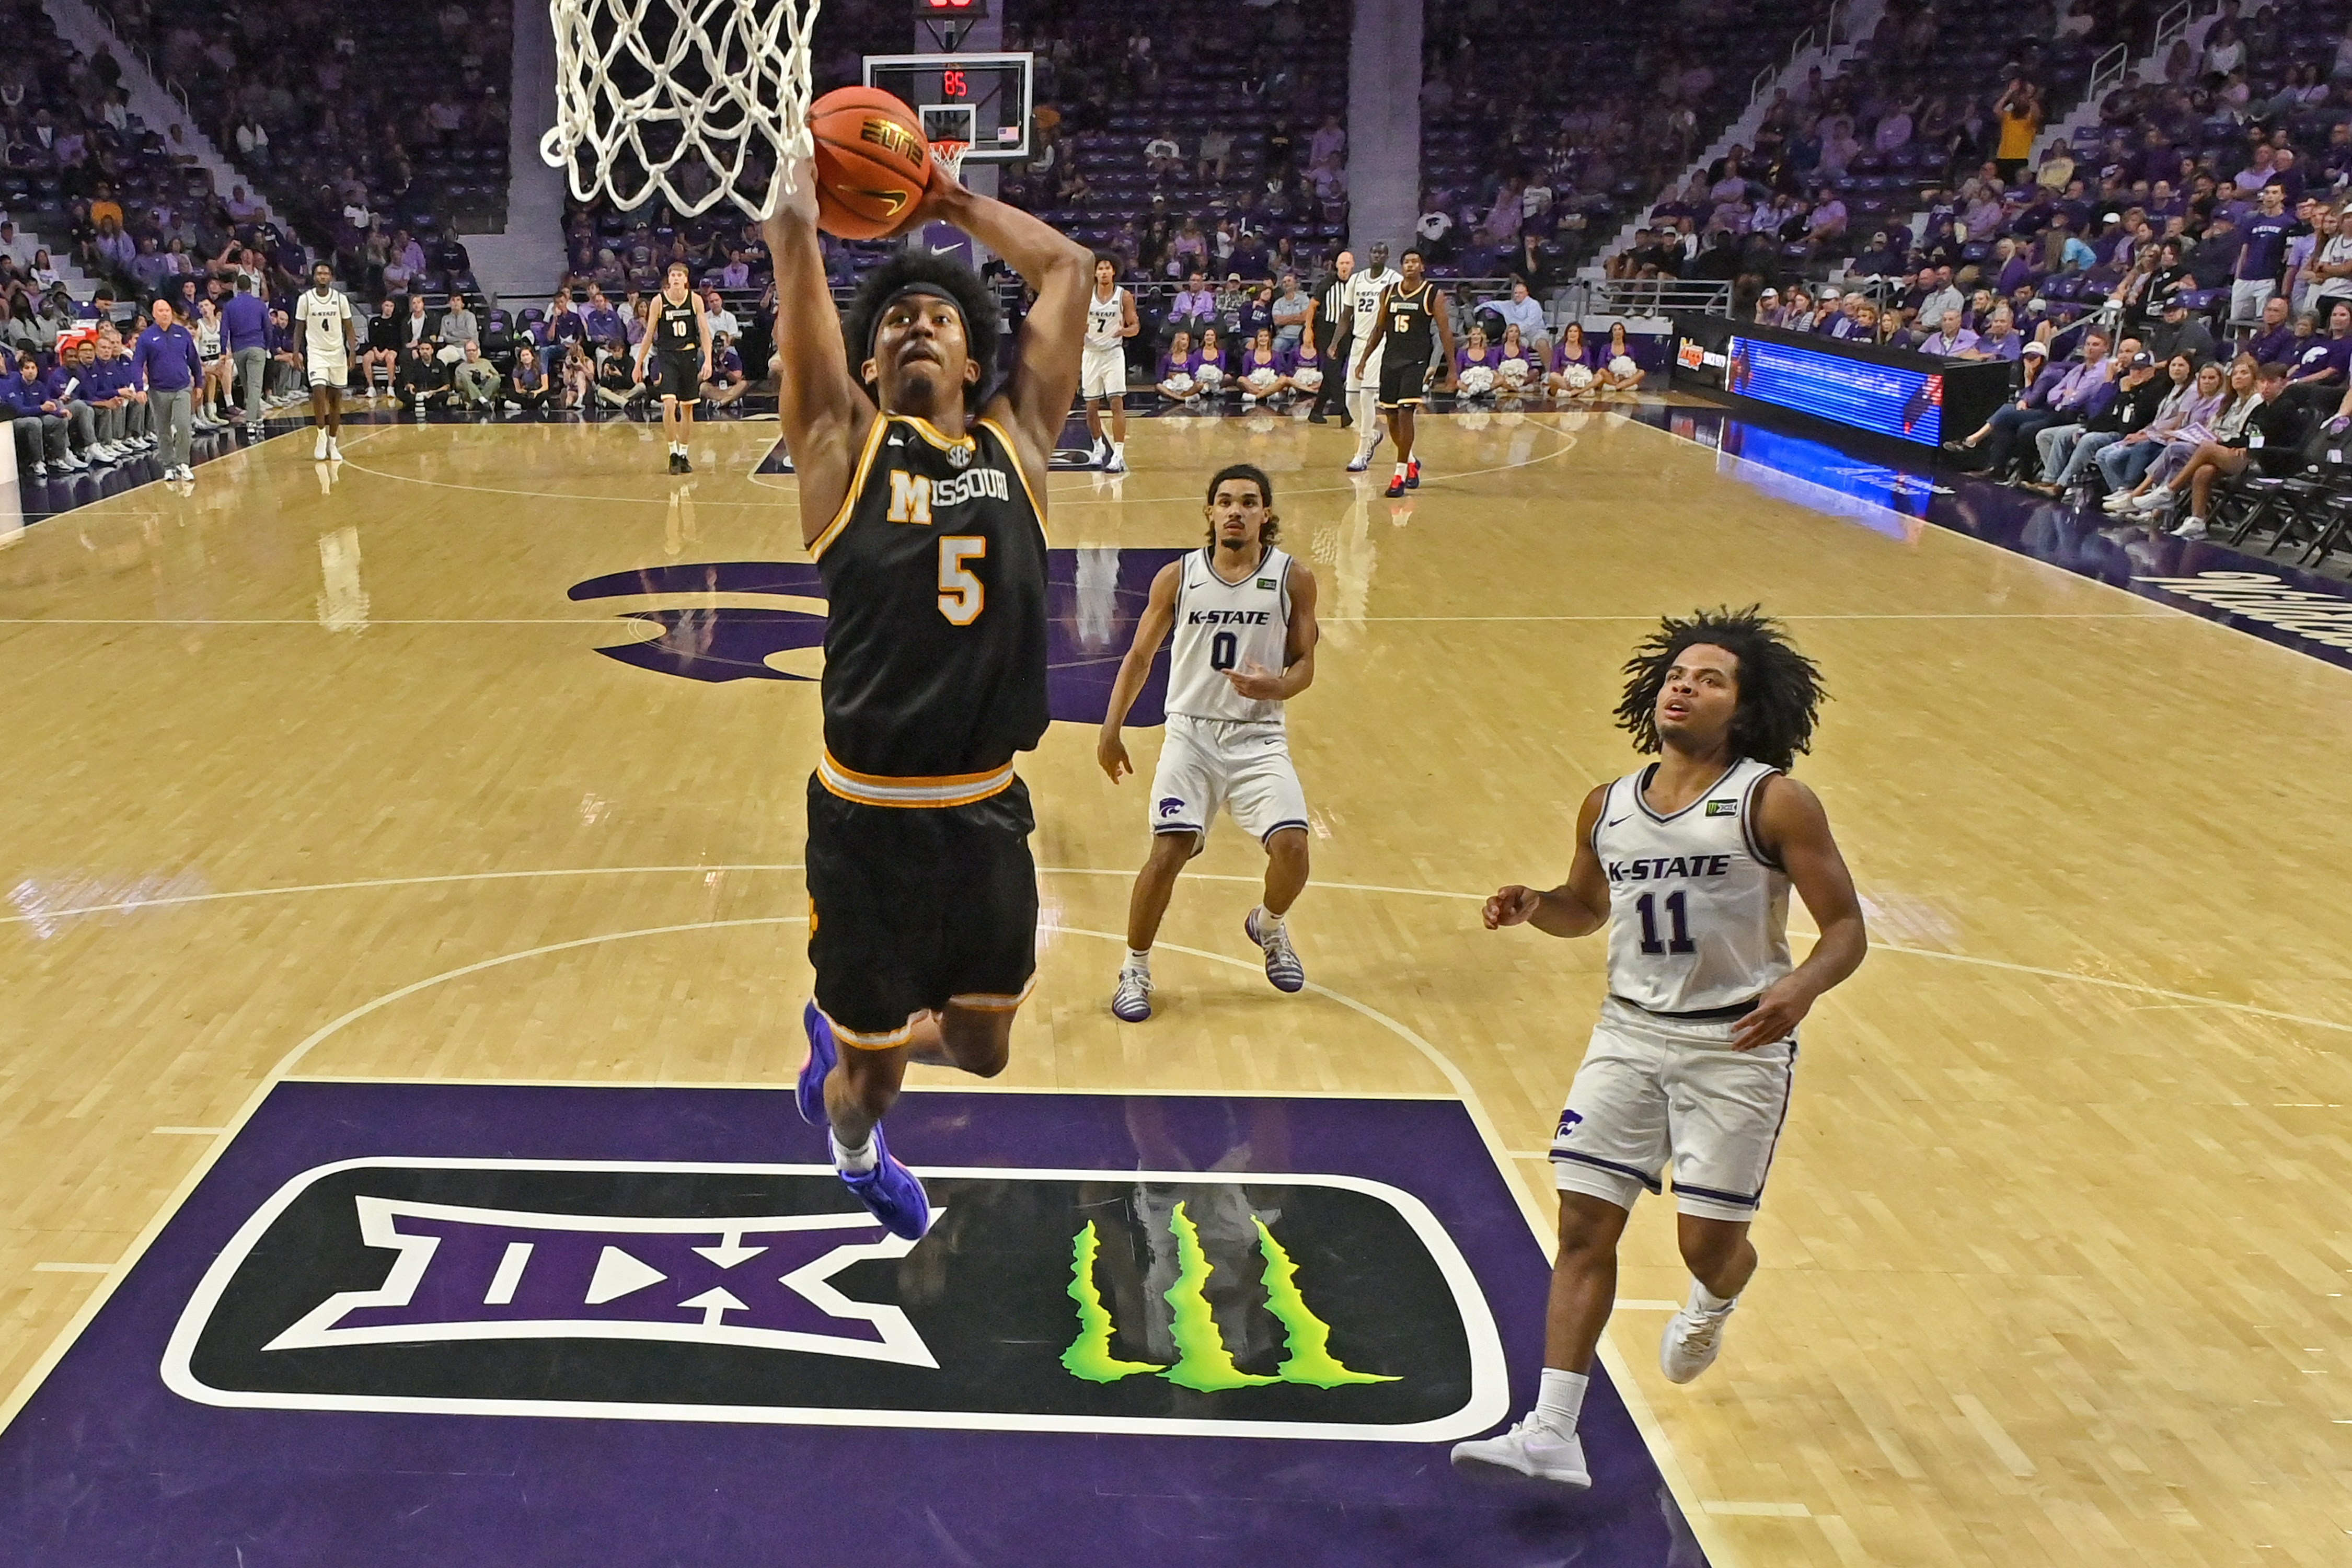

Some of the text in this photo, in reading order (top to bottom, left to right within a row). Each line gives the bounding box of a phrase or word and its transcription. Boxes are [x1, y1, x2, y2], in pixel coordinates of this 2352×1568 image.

[944, 71, 967, 97] 85
[861, 116, 924, 169] ELITE
[1358, 298, 1375, 313] 22
[321, 318, 330, 331] 4
[672, 320, 687, 337] 10
[1097, 319, 1106, 333] 7
[1394, 314, 1411, 333] 15
[948, 445, 971, 465] SEC
[886, 468, 1009, 525] MISSOURI
[938, 535, 986, 626] 5
[1189, 610, 1270, 625] K-STATE
[1210, 631, 1237, 671] 0
[1609, 854, 1731, 882] K-STATE
[1635, 890, 1697, 955] 11
